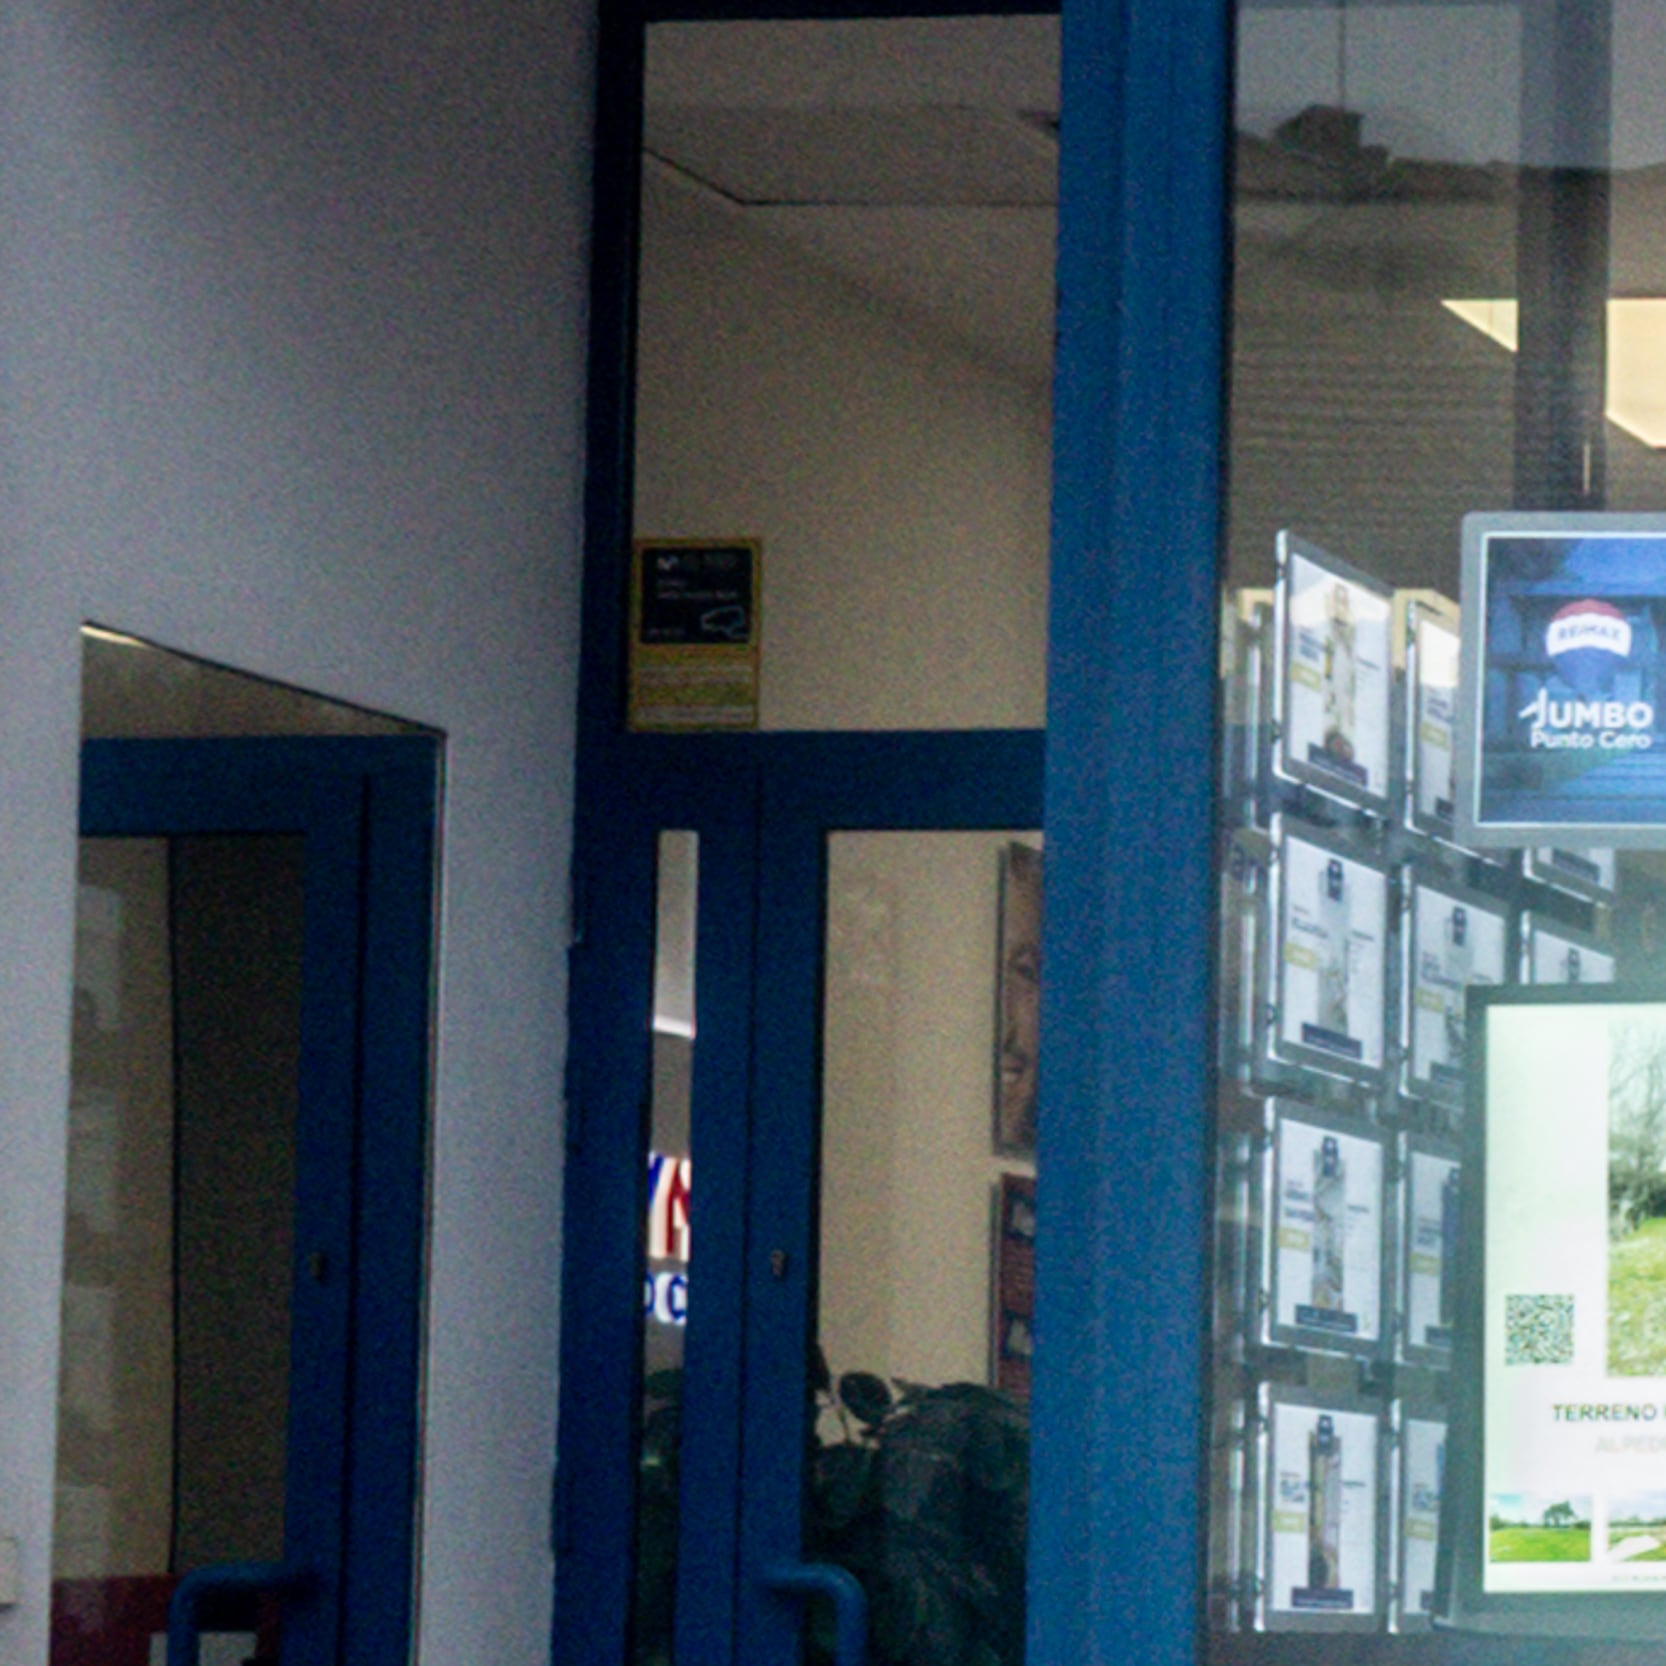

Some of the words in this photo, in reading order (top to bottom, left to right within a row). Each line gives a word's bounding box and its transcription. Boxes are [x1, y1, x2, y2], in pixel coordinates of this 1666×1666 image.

[1519, 688, 1654, 730] JUMBO
[1530, 731, 1595, 750] Punto
[1599, 731, 1652, 750] Cero
[1553, 1402, 1657, 1422] TERRENO
